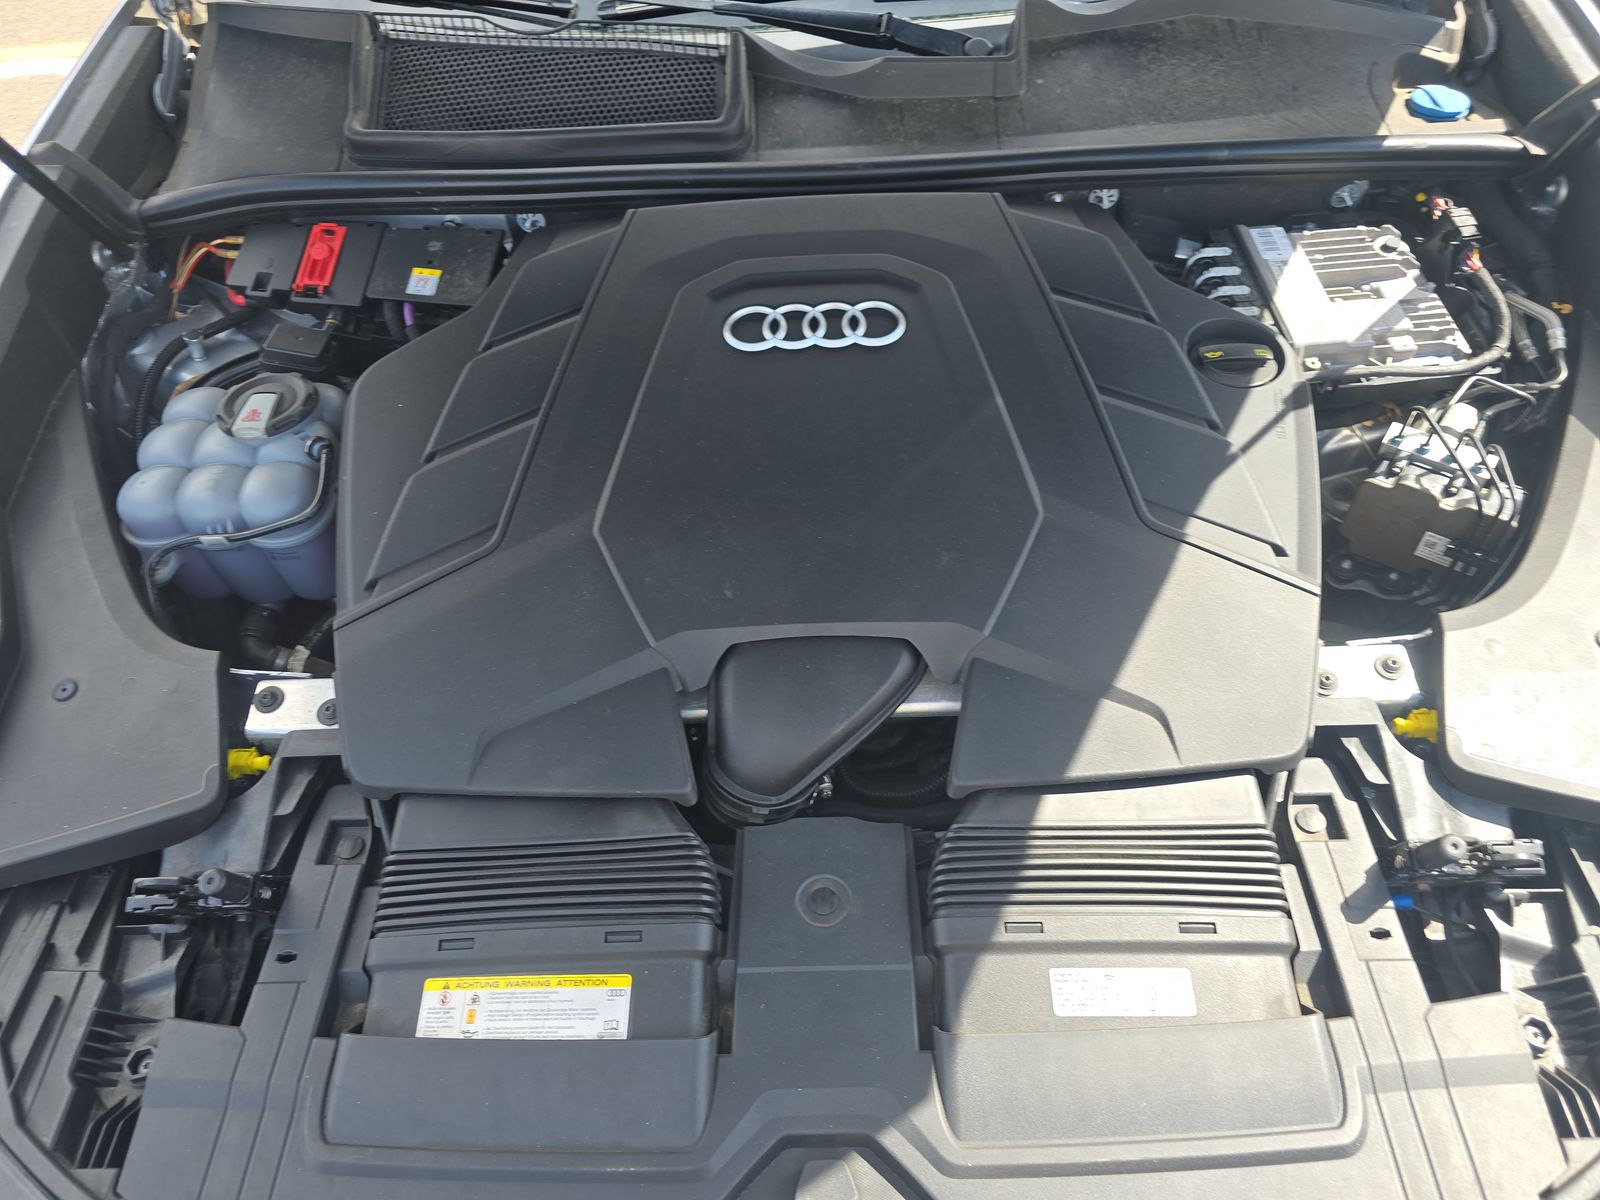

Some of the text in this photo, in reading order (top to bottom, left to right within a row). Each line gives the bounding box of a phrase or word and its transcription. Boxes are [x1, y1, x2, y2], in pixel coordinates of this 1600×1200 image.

[455, 978, 608, 989] ACHTUNG WARNING ATTENTION
